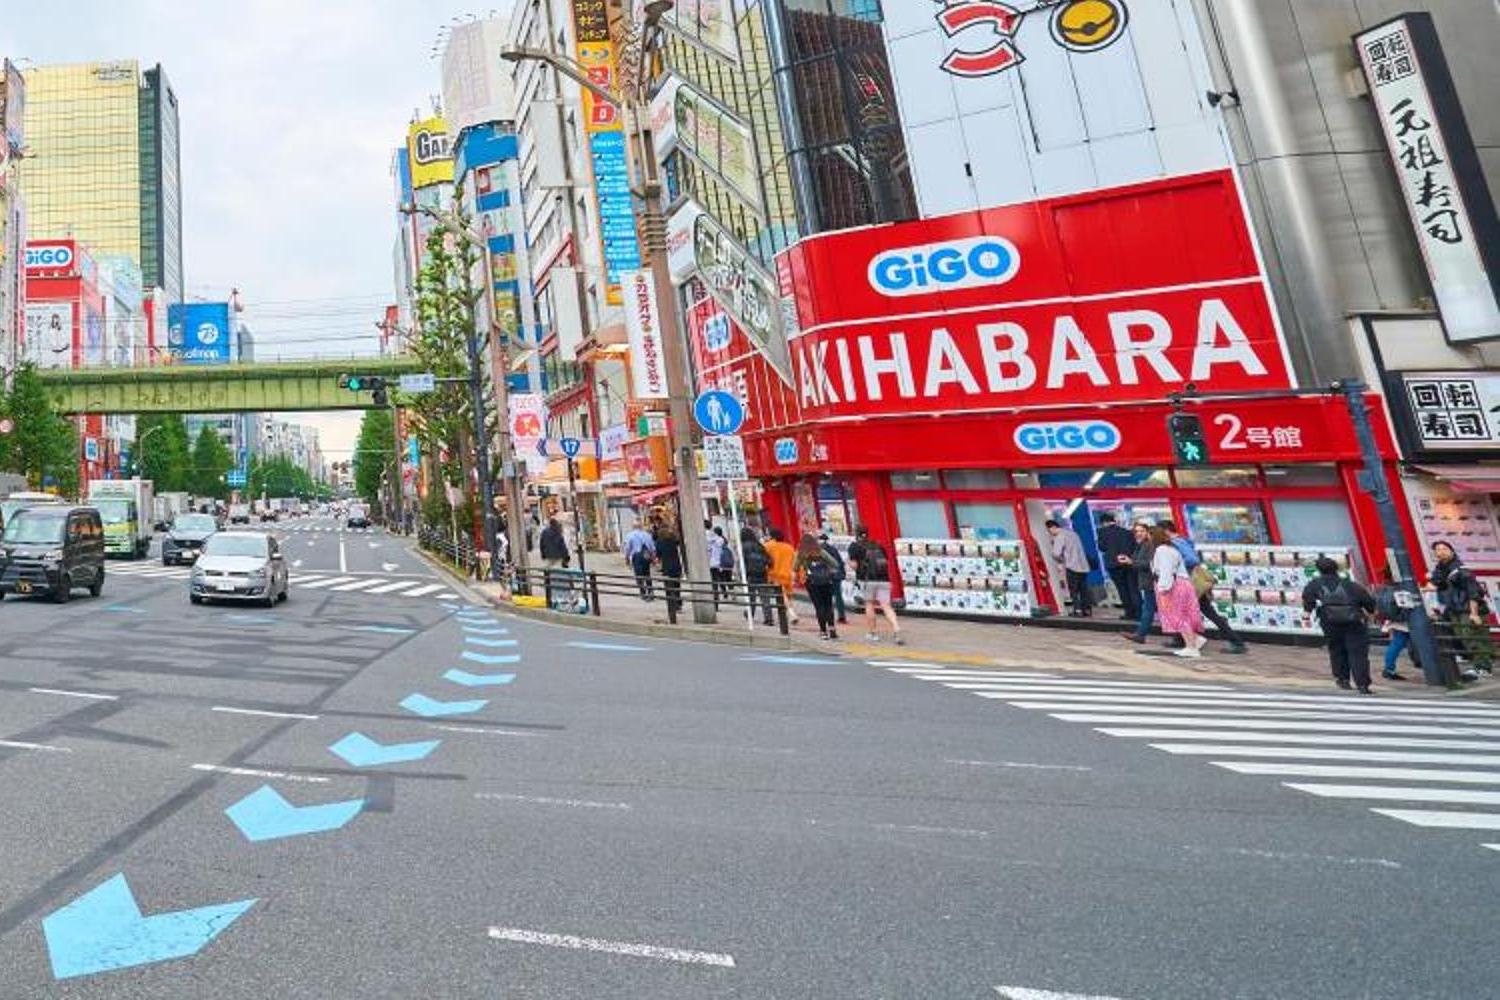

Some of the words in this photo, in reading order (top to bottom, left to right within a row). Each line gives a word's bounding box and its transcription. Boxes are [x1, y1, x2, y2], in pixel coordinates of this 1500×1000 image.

[1390, 97, 1463, 244] 元祖寿司
[874, 242, 1014, 292] GiGO
[799, 299, 1269, 409] AKIHABARA
[1411, 383, 1476, 408] 回転
[1018, 422, 1117, 451] GiGO
[1212, 413, 1303, 451] 2号館
[1421, 413, 1485, 437] 寿司
[564, 440, 577, 453] 17
